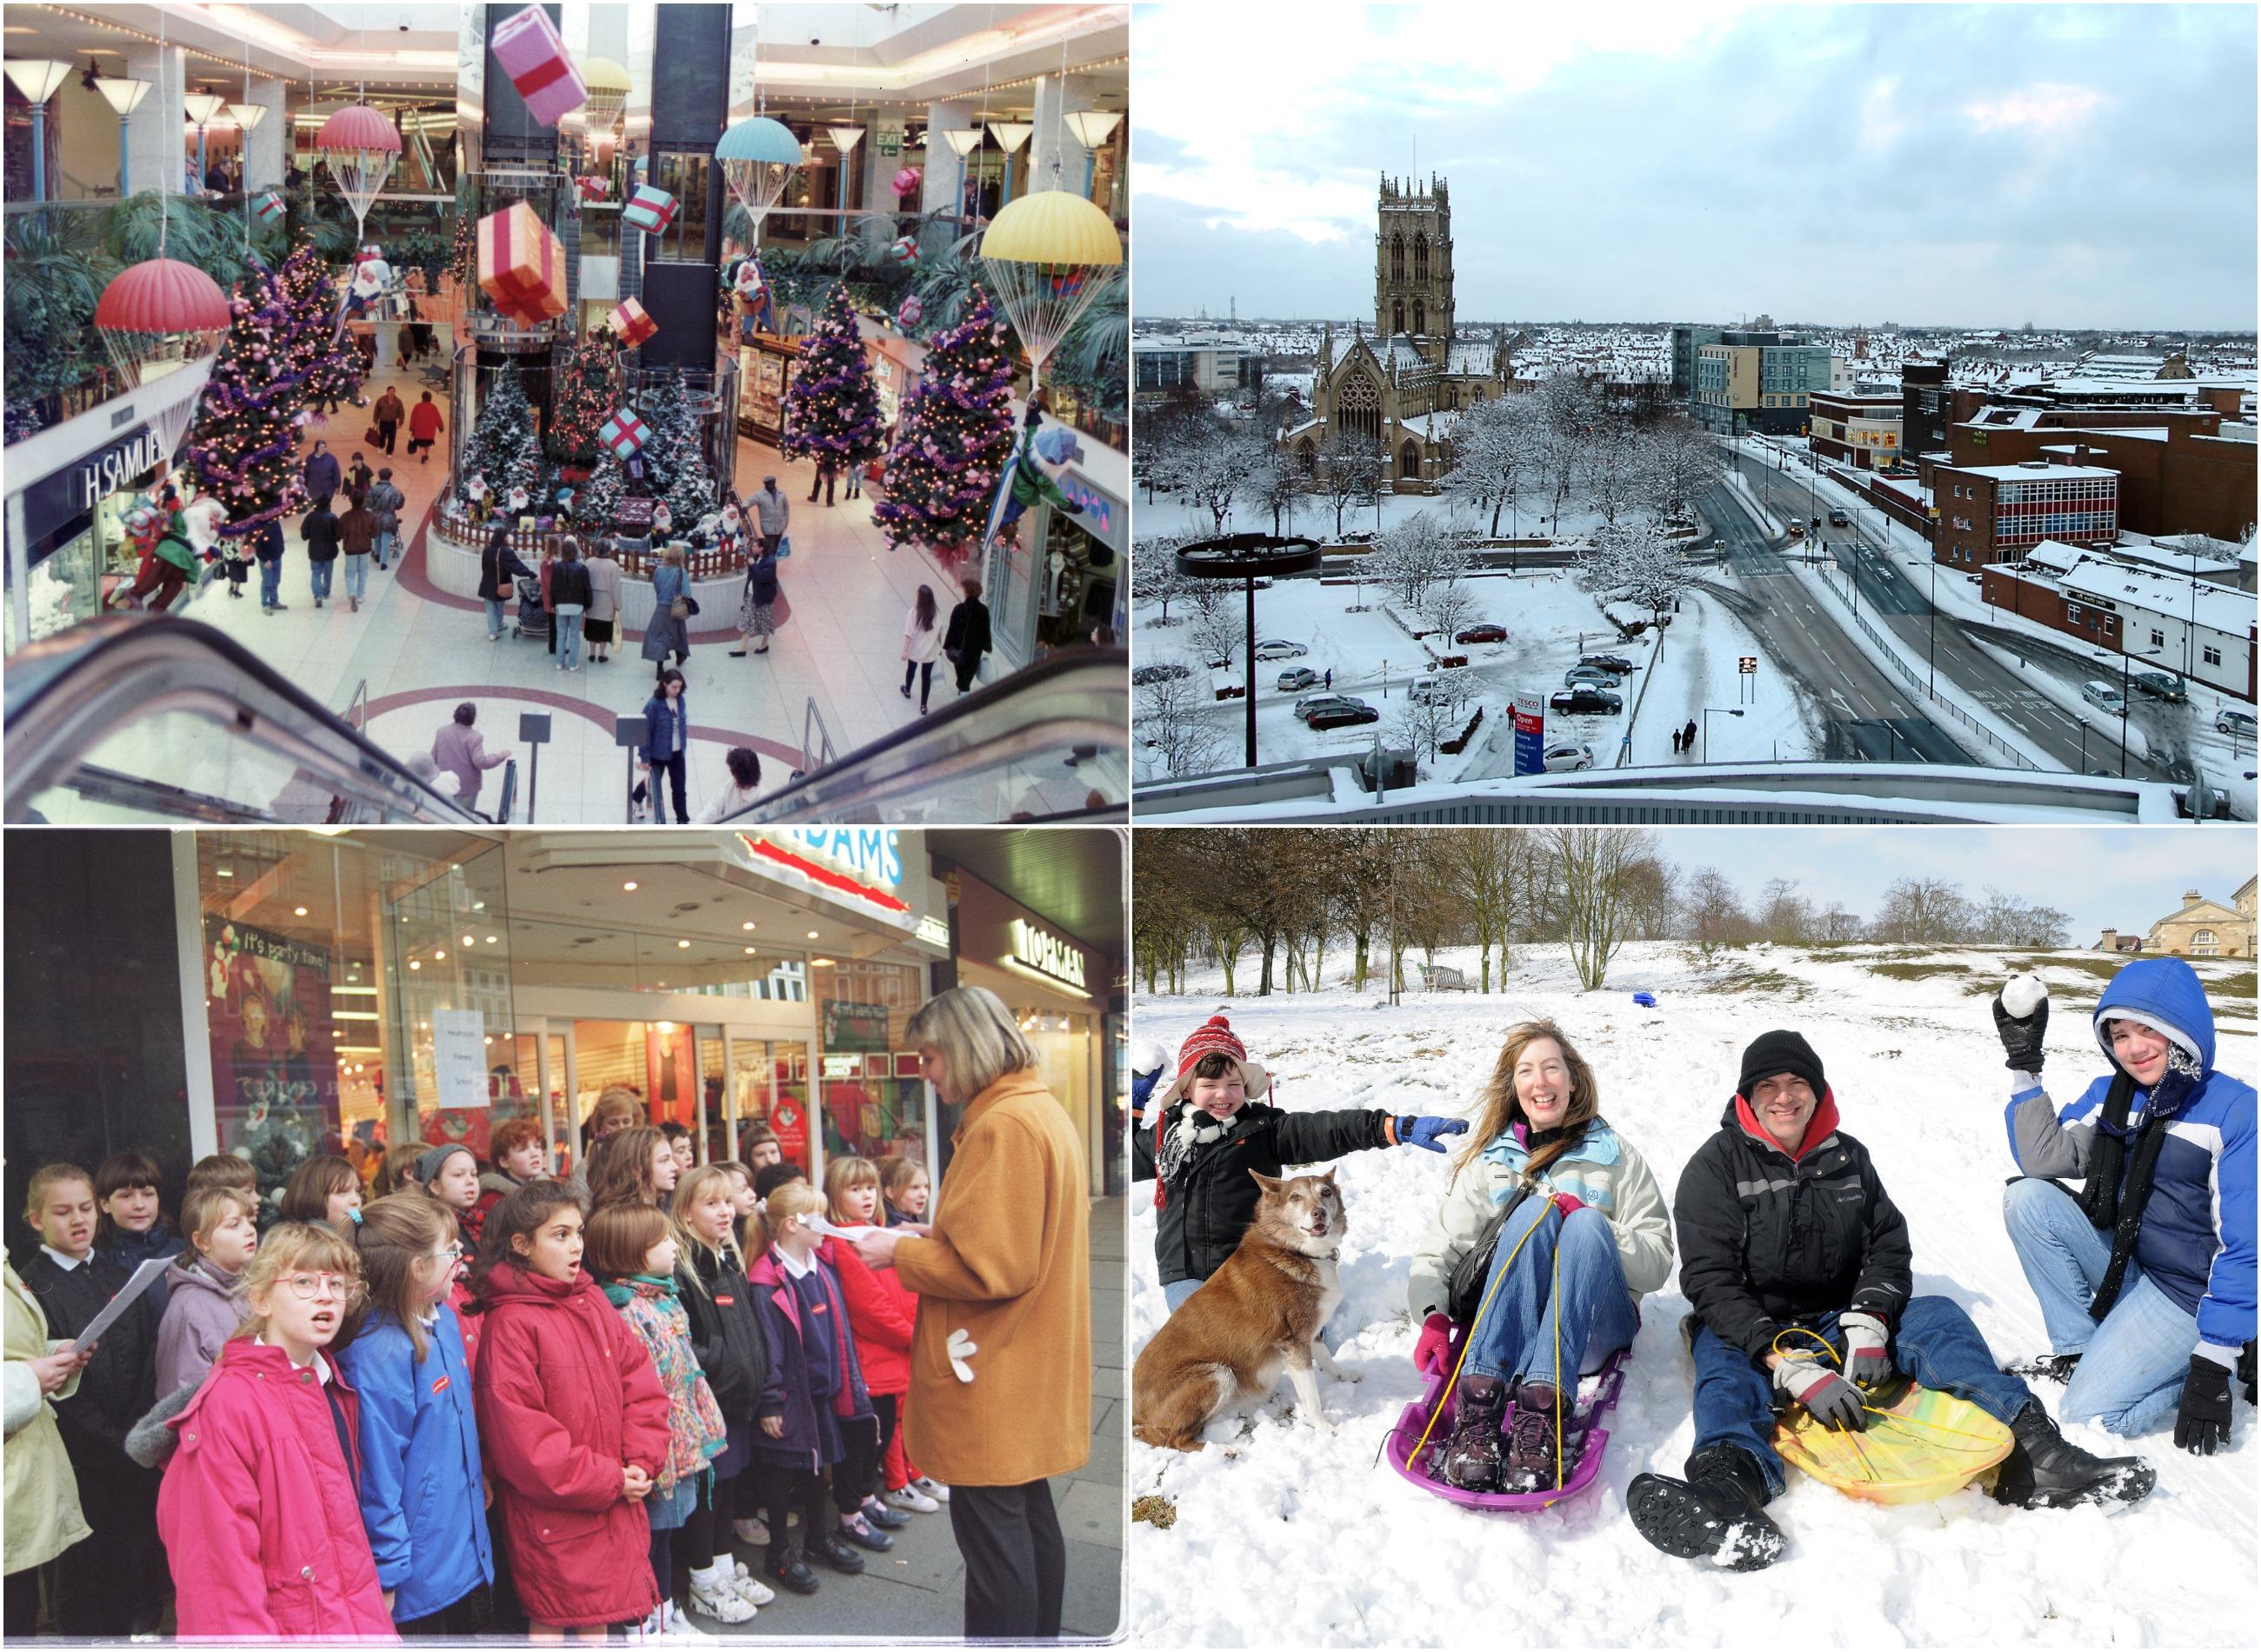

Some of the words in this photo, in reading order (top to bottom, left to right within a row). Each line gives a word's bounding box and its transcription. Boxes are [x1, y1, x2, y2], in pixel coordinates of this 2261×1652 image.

[877, 132, 904, 146] EXIT
[1517, 698, 1538, 708] TESCO
[1517, 714, 1533, 724] Open
[244, 932, 264, 954] It's
[269, 942, 299, 964] party
[302, 949, 327, 969] time!
